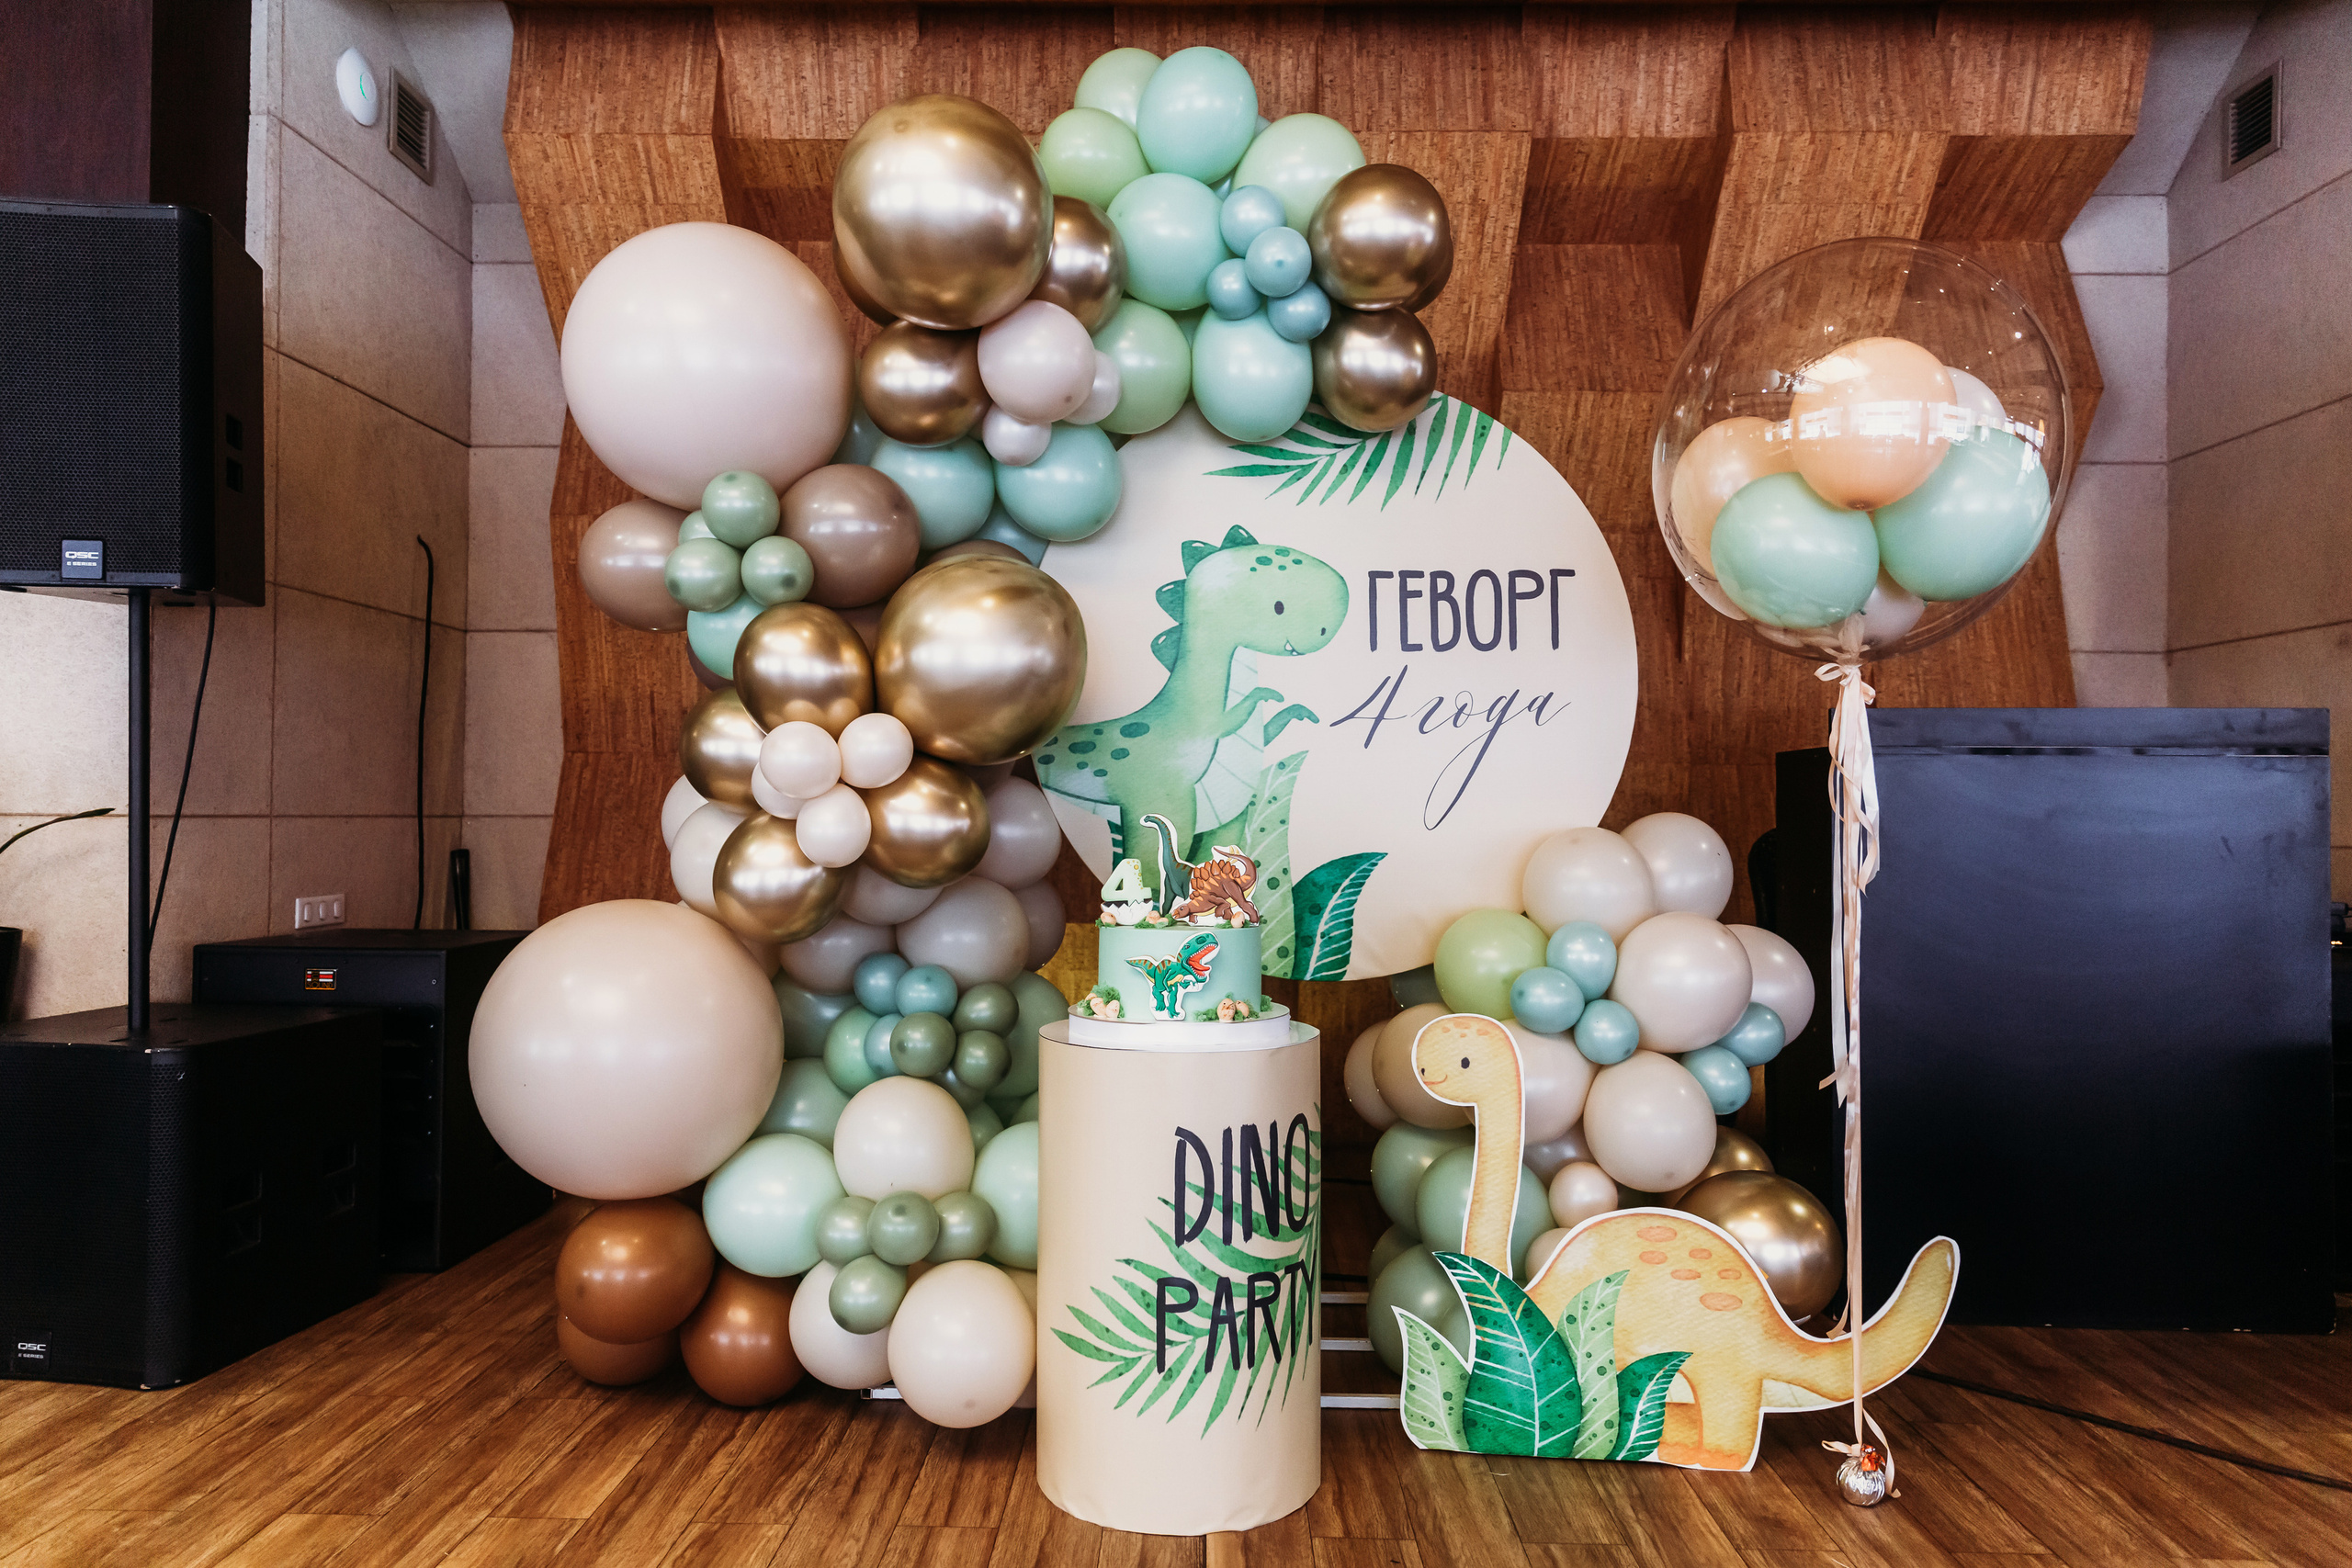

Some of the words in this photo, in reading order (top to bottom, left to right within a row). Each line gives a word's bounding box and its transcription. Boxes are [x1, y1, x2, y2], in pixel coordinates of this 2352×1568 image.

[65, 551, 99, 559] QSC
[1368, 568, 1577, 653] ГЕВОРГ
[1329, 664, 1408, 750] 4
[1410, 688, 1572, 830] года
[1101, 858, 1152, 904] 4
[1174, 1112, 1310, 1248] DINO
[17, 1342, 47, 1351] QSC
[1156, 1249, 1317, 1375] PARTY
